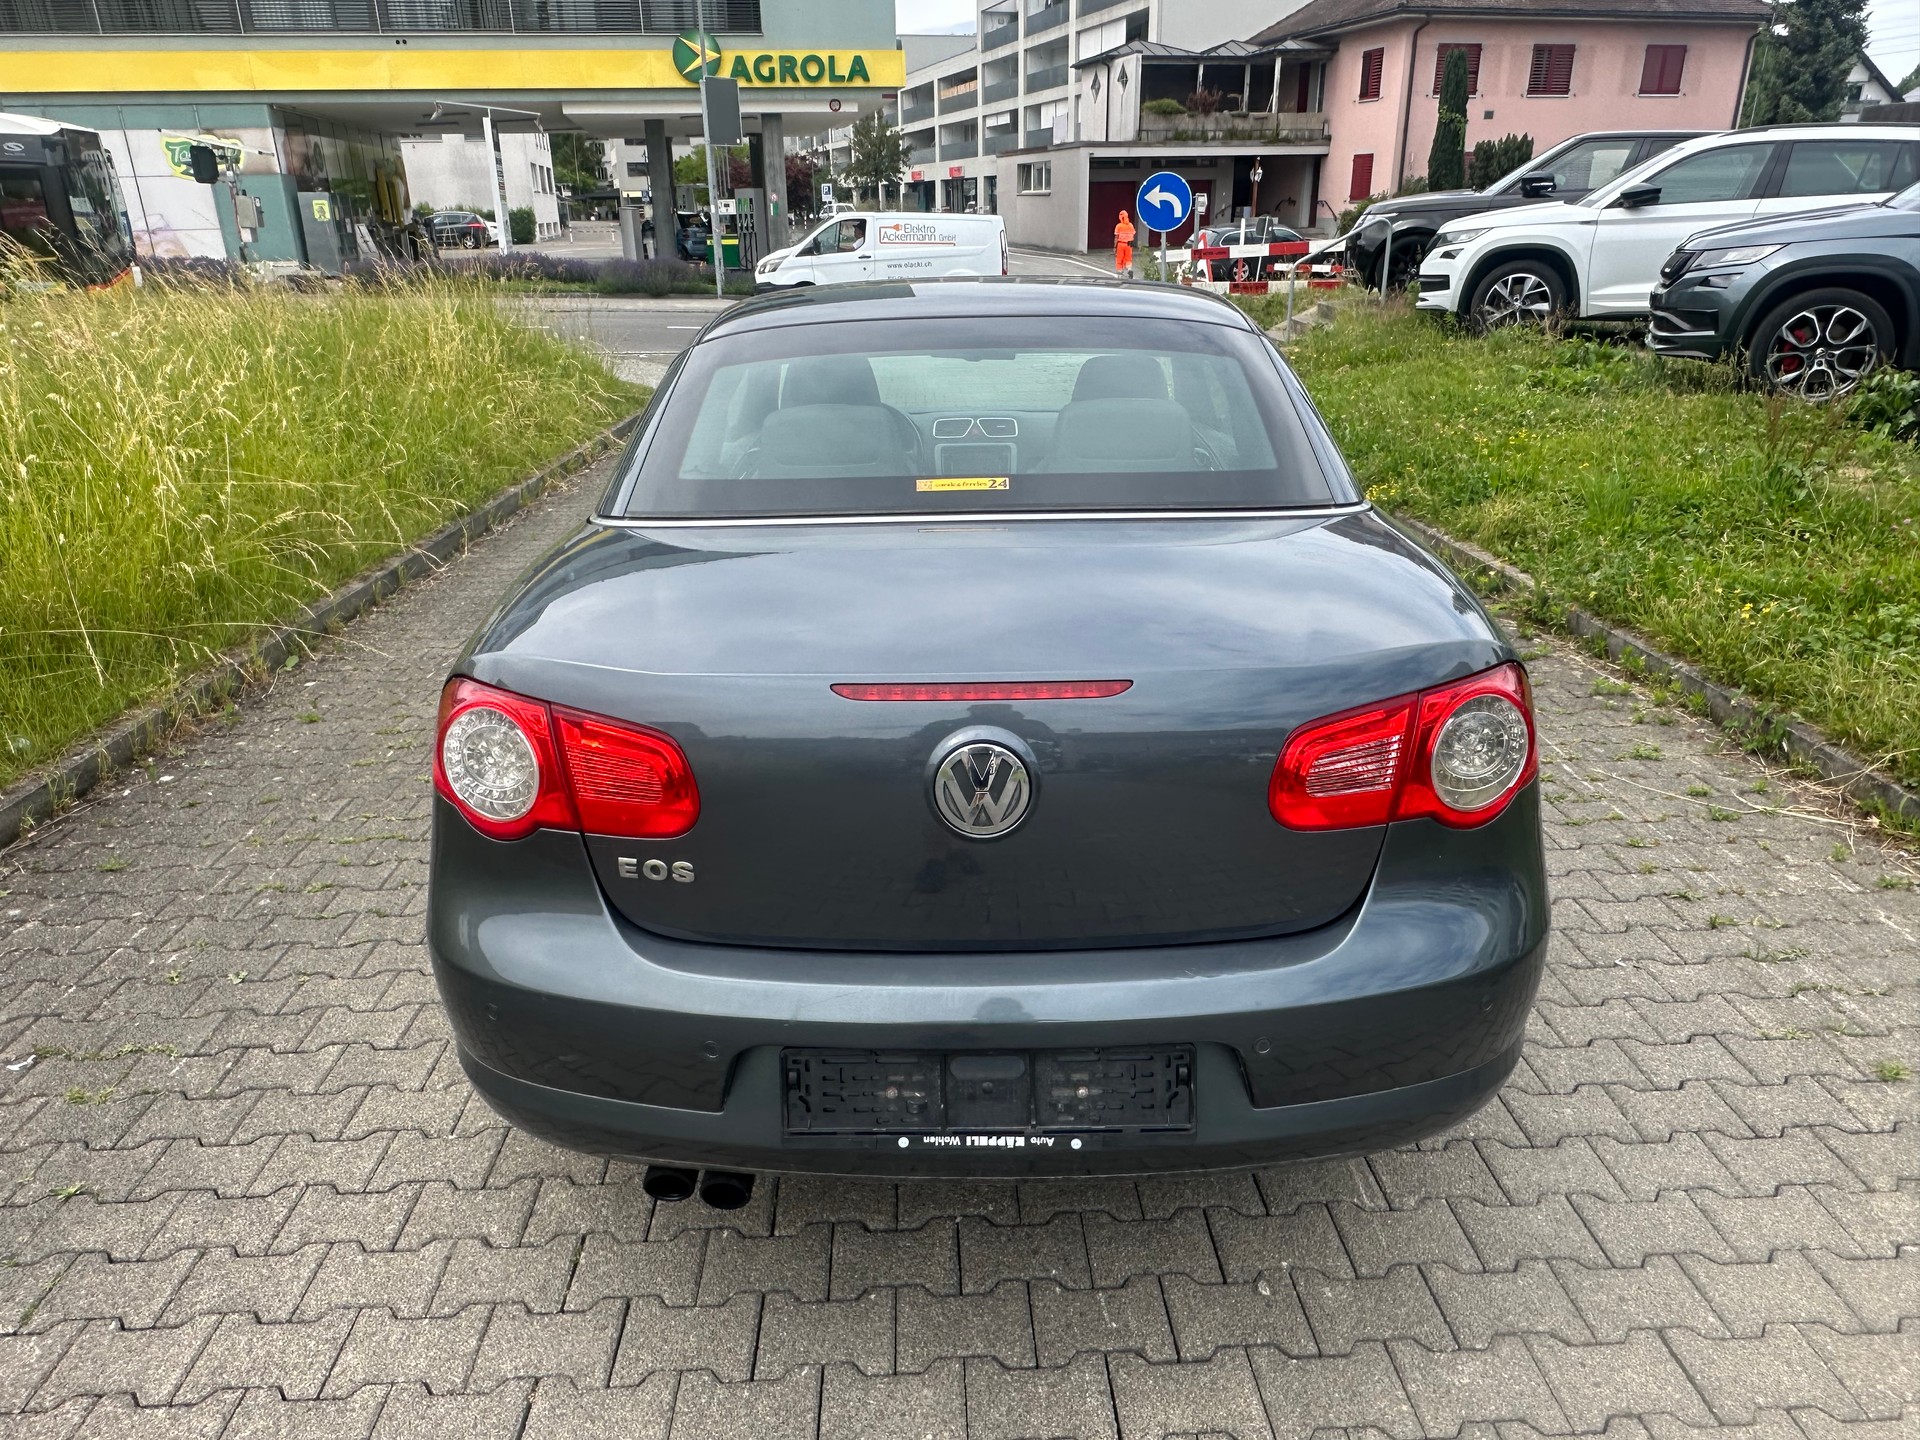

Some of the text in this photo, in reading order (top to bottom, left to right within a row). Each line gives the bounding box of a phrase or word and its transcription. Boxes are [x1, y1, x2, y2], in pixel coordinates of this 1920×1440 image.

[730, 54, 870, 83] AGROLA
[903, 223, 936, 234] Elektro
[881, 231, 957, 242] Ackermann GmbH
[988, 479, 1008, 489] 24
[618, 856, 695, 883] EOS
[923, 1135, 961, 1147] Wohlen
[1030, 1136, 1055, 1147] Auto
